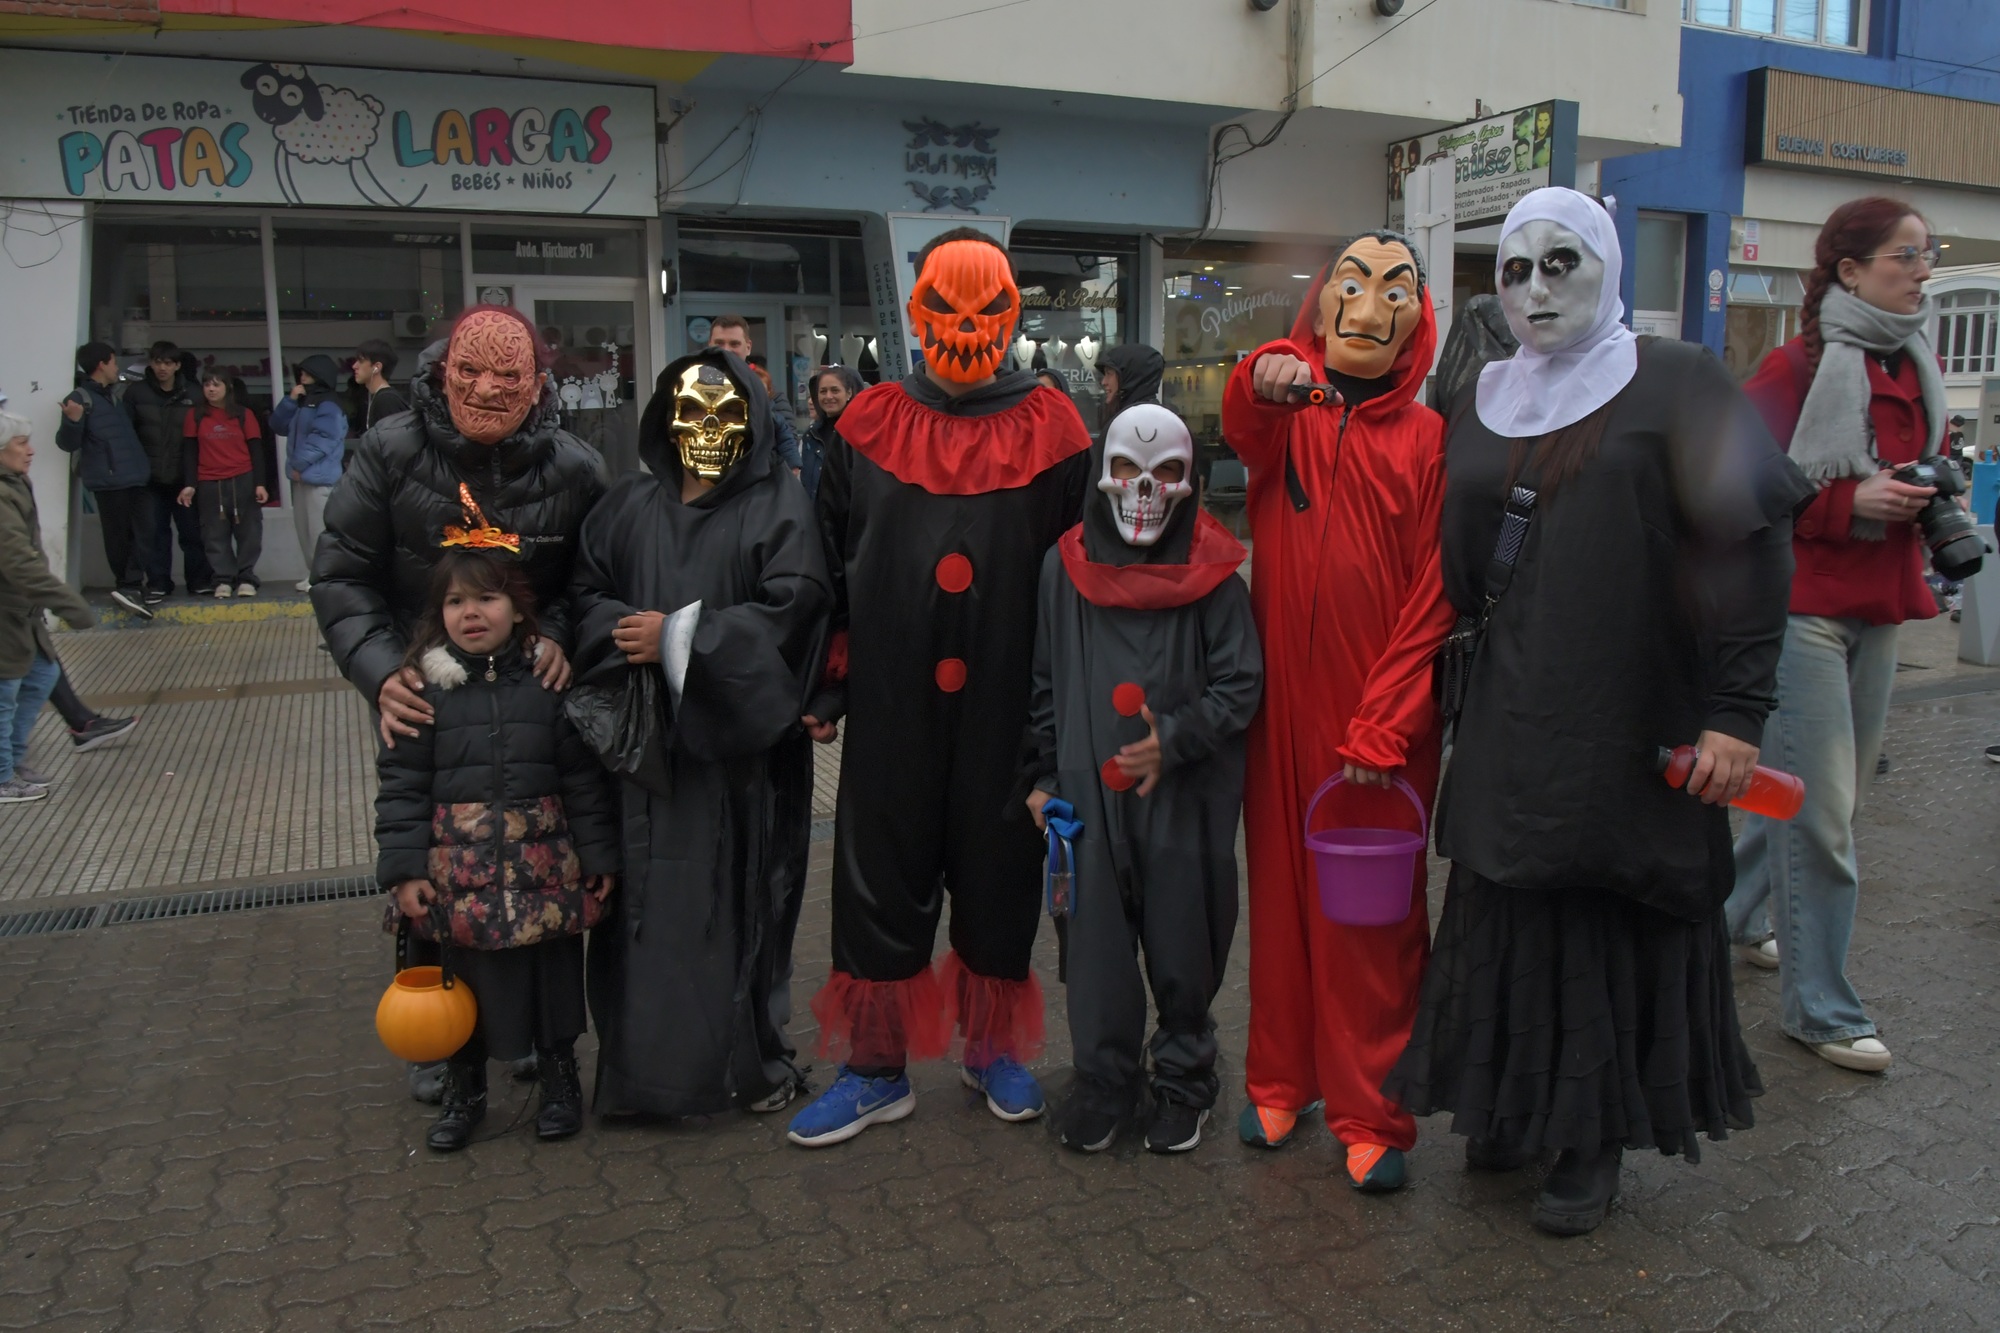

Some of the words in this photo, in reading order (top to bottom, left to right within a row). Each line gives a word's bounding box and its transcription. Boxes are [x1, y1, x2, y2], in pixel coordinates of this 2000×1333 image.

[141, 103, 168, 121] De
[173, 101, 221, 121] RoPa
[392, 105, 613, 168] LARGAS
[58, 122, 253, 196] PATAS
[1778, 135, 1825, 156] BUENAS
[1831, 142, 1908, 166] COSTUMBRES
[1500, 176, 1531, 191] Rapados
[1454, 198, 1475, 210] trición
[1481, 191, 1509, 204] Alisados
[1462, 205, 1501, 219] Localizadas
[515, 241, 540, 258] Avda.
[541, 242, 577, 259] Kirchner
[579, 242, 594, 259] 917
[873, 264, 884, 306] CAMBIO
[883, 261, 894, 304] MALLAS
[1053, 289, 1066, 309] &
[880, 312, 886, 326] DE
[890, 310, 897, 325] EN
[892, 331, 899, 345] EL
[882, 332, 892, 367] PILAS
[896, 353, 904, 380] ACTO
